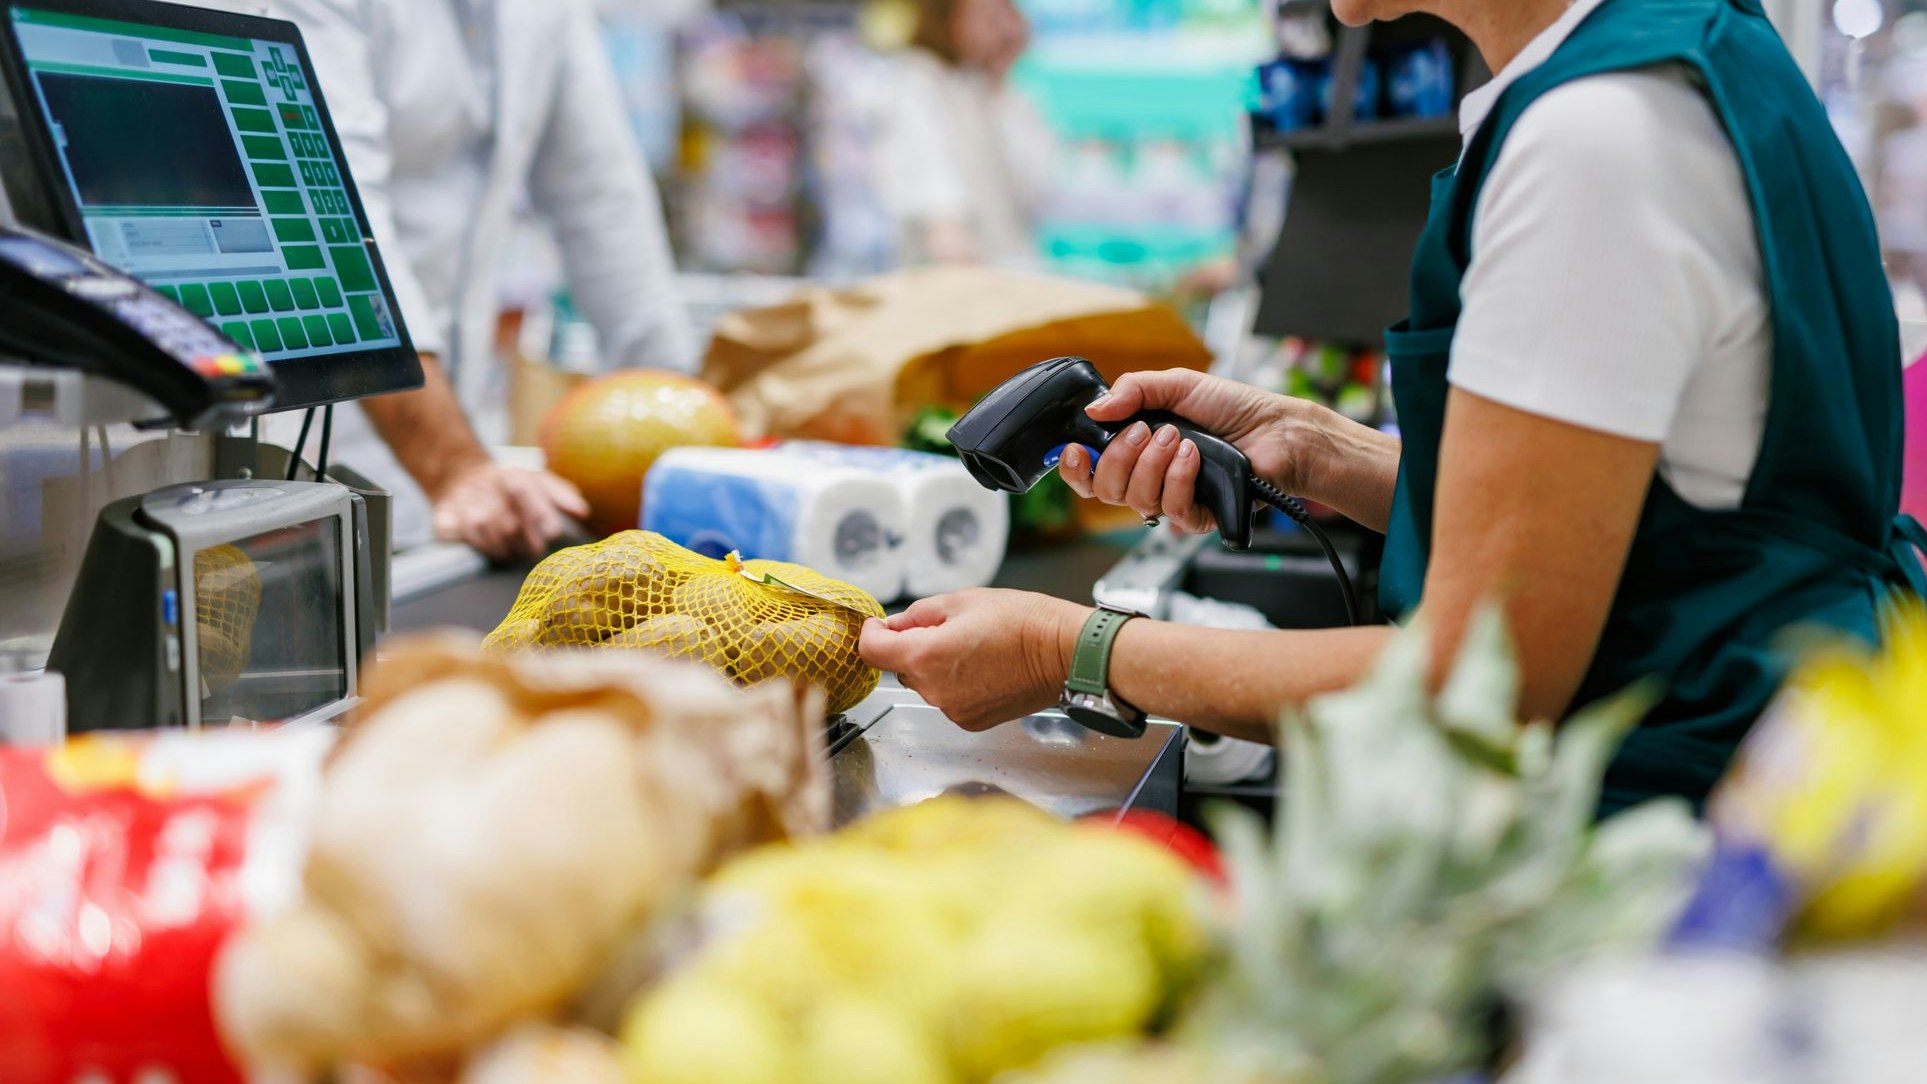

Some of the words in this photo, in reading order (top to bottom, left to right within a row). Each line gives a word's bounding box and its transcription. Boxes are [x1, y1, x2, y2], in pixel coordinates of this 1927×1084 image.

[292, 138, 298, 150] 7
[304, 167, 310, 178] 4
[325, 196, 332, 207] 2
